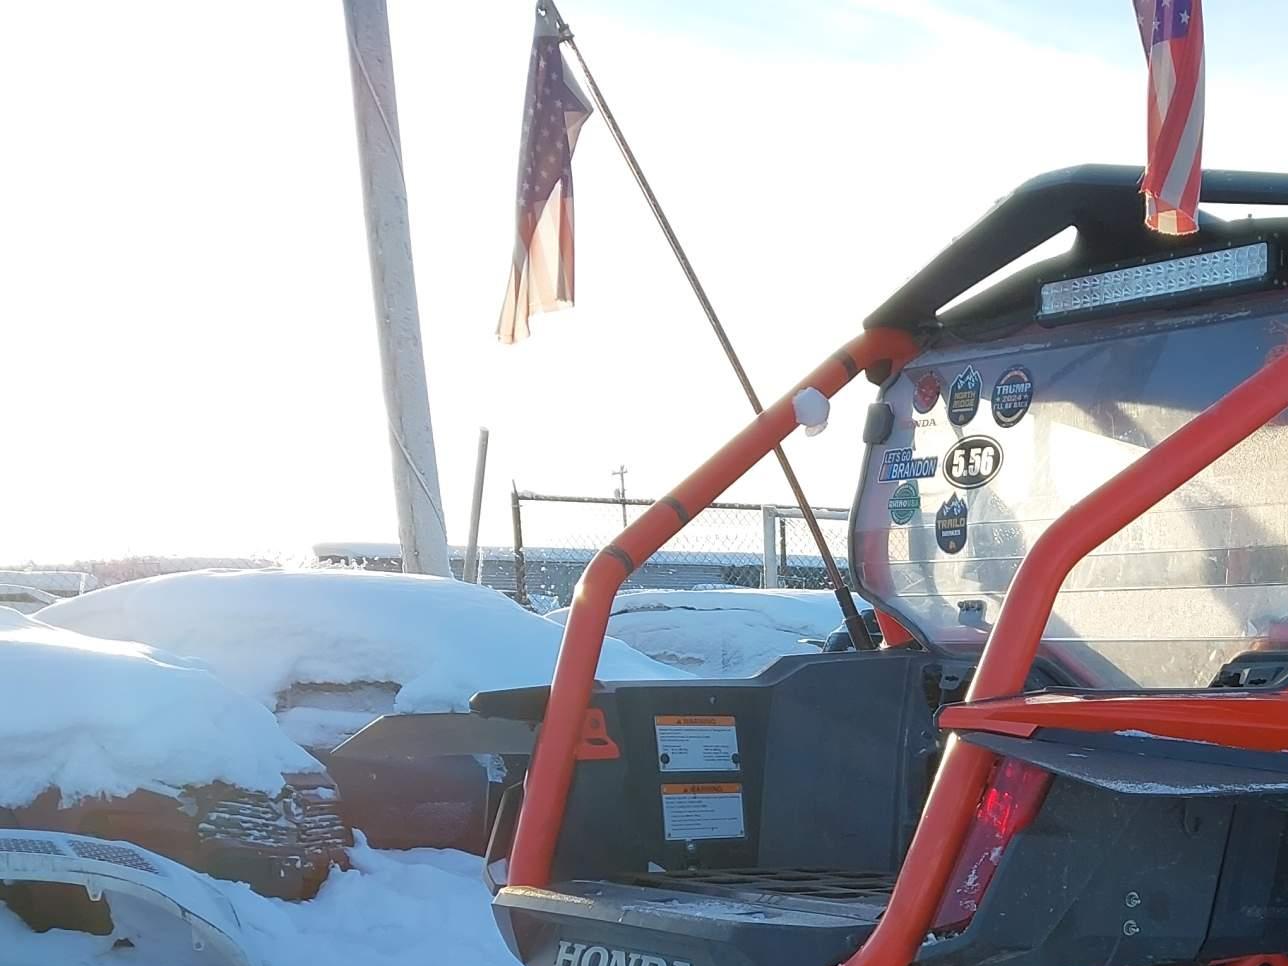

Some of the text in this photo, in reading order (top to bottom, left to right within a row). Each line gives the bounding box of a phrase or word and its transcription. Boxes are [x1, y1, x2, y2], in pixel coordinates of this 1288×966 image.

[996, 383, 1031, 395] TRUMP
[1002, 395, 1022, 403] 2024
[892, 458, 937, 479] BRANDON
[951, 446, 995, 478] 5.56
